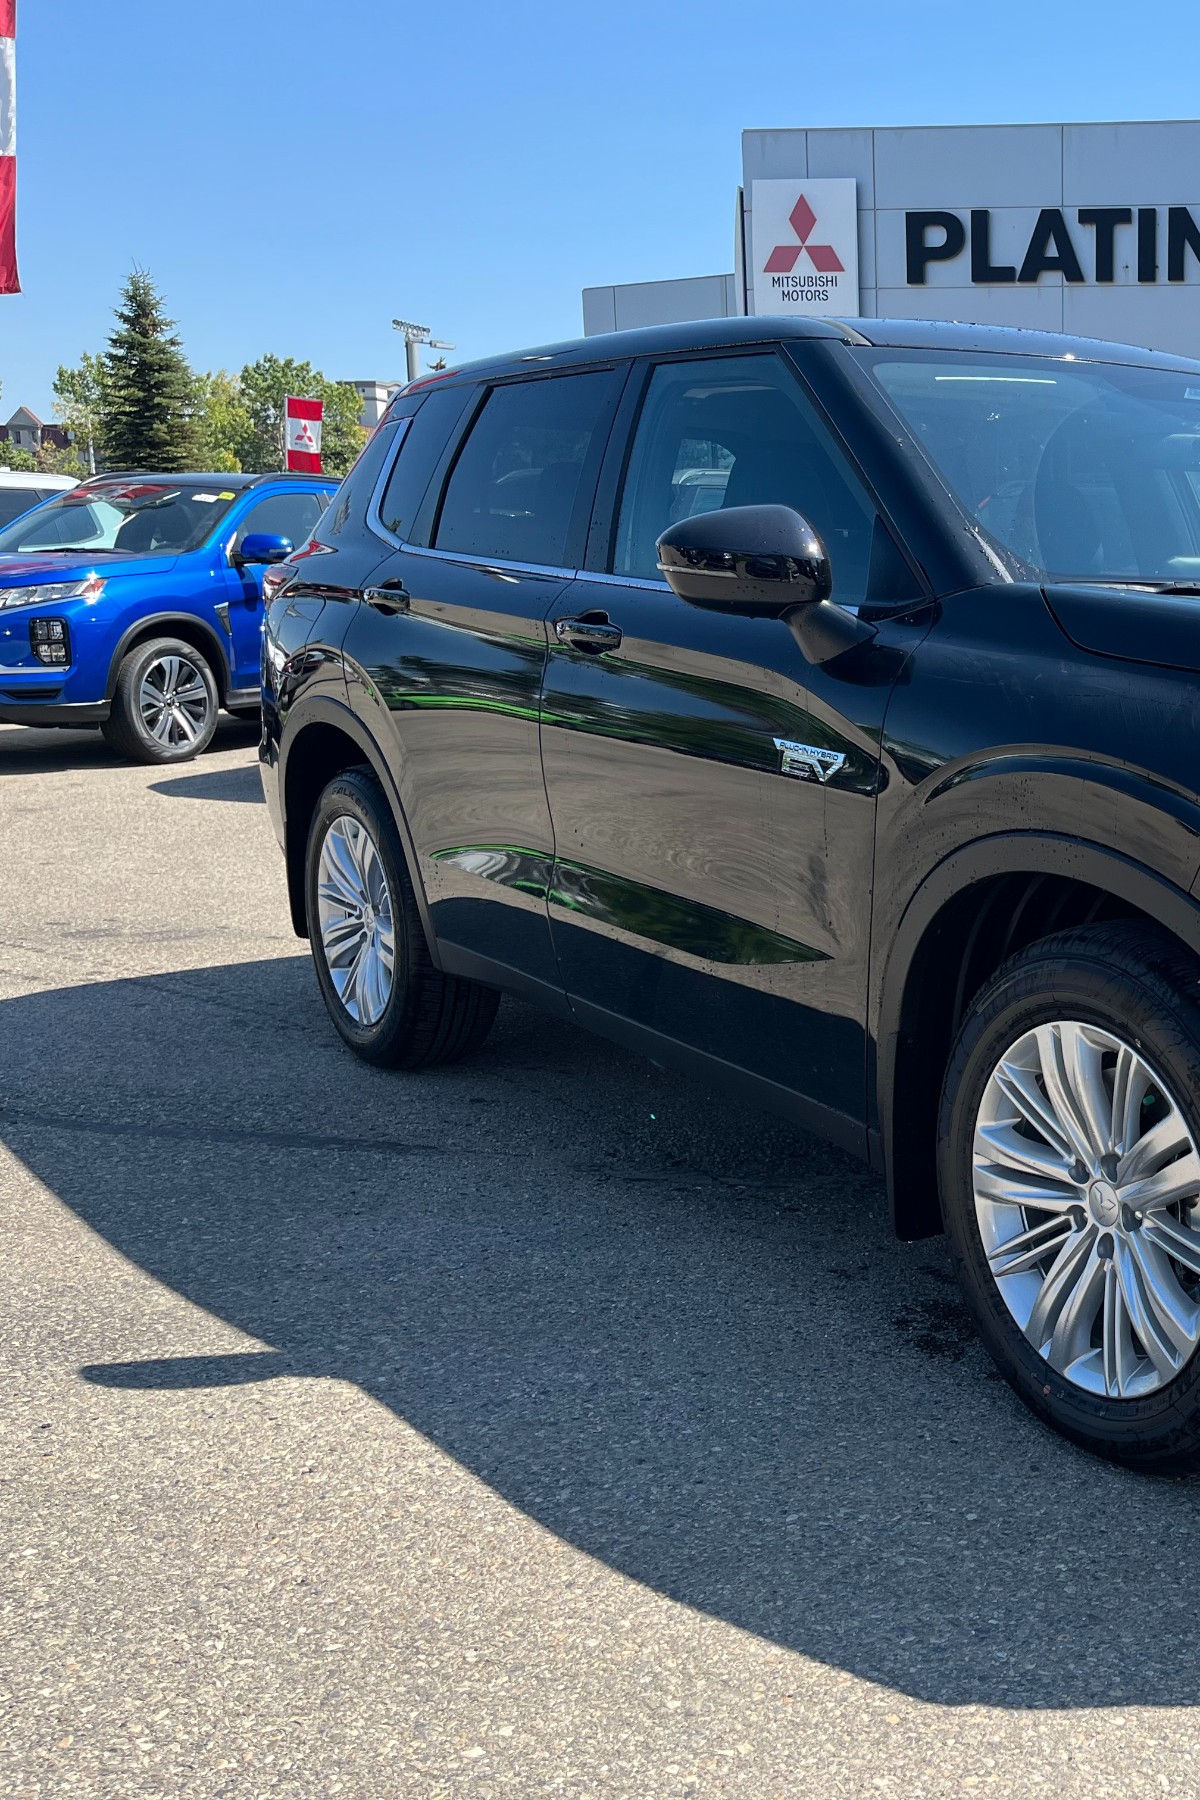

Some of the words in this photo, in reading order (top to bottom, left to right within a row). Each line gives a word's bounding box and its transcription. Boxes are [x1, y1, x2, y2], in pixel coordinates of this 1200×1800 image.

[772, 275, 838, 288] MITSUBISHI
[781, 289, 829, 302] MOTORS
[809, 750, 839, 762] HYBRID
[331, 786, 369, 817] FALKEN
